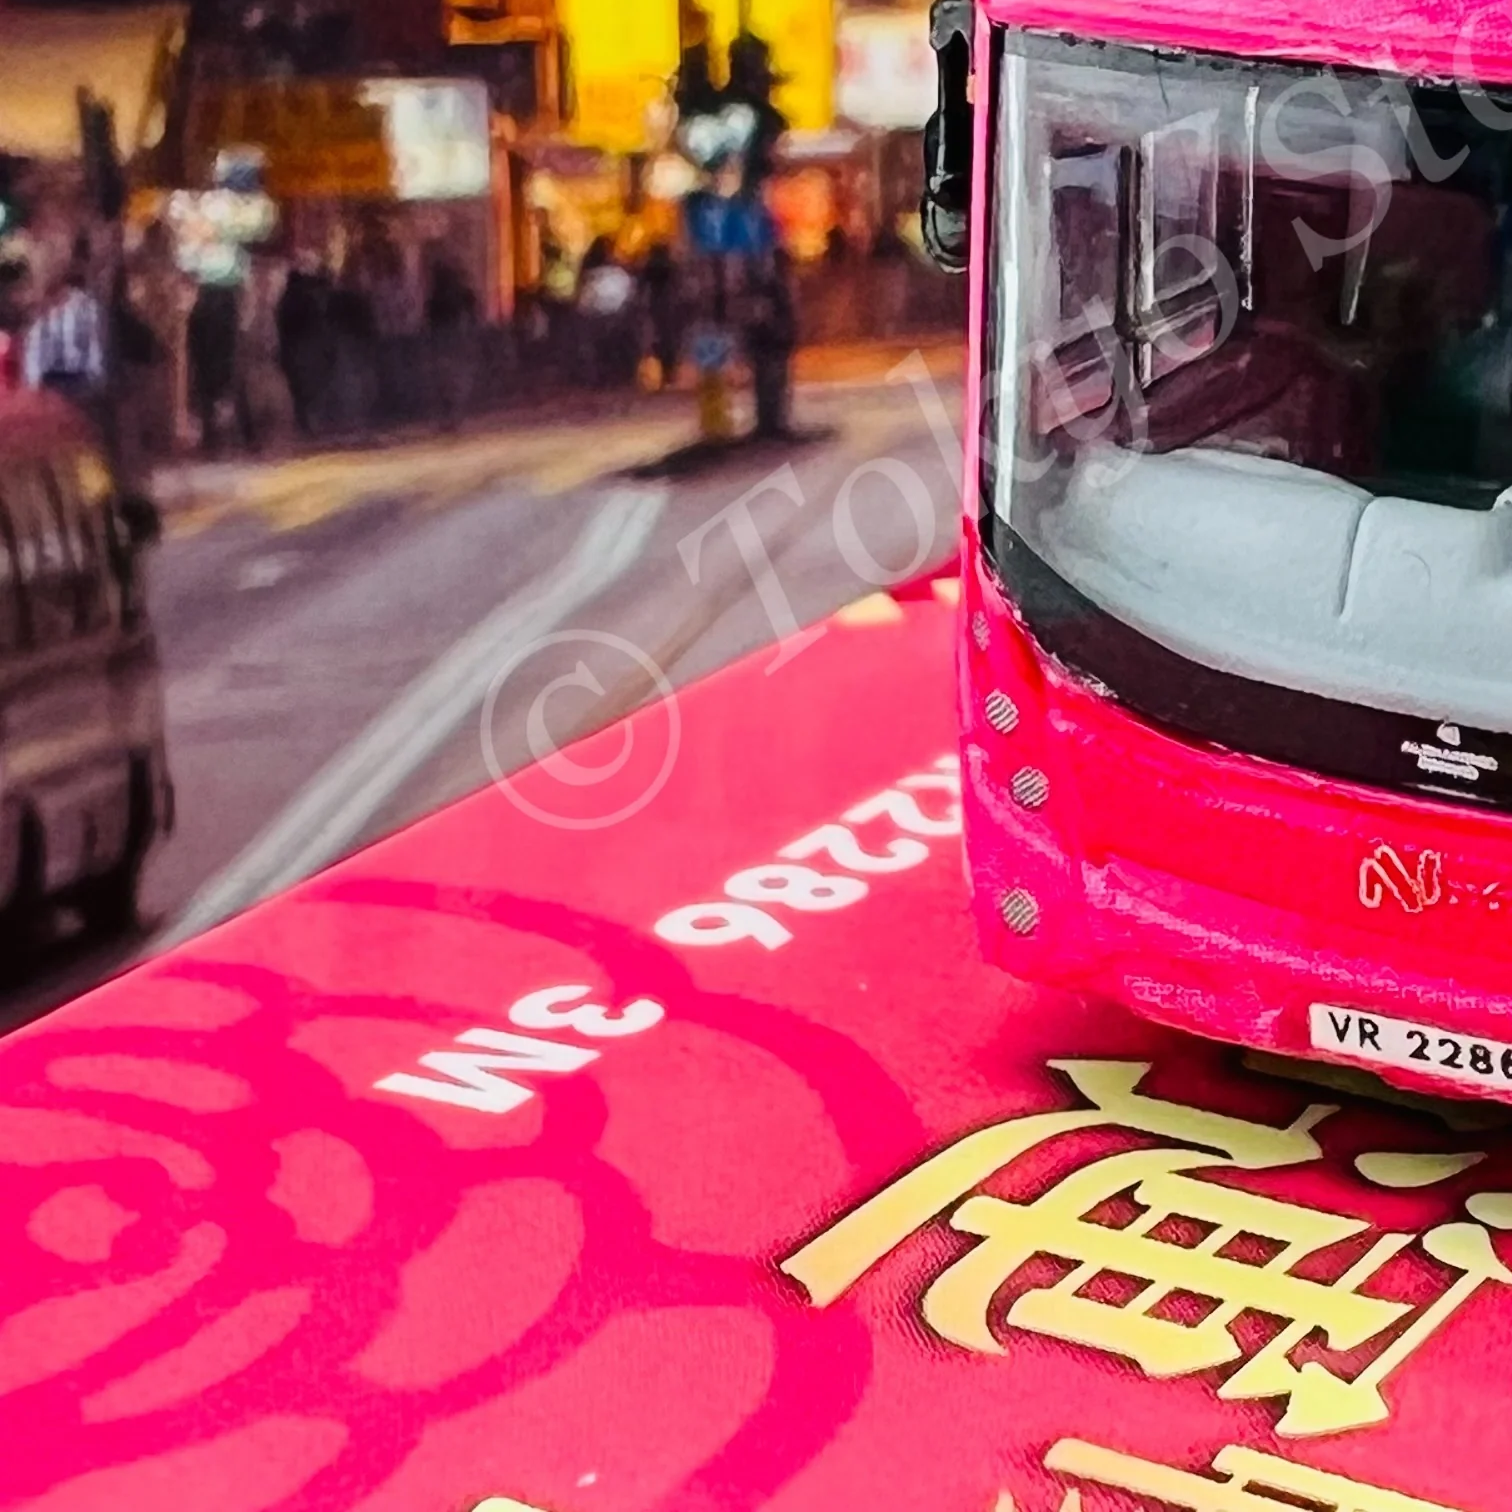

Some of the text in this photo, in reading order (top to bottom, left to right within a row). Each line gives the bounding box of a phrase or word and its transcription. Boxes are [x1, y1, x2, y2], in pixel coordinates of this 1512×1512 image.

[372, 752, 962, 1115] 2286 3M
[1327, 1009, 1383, 1052] VR
